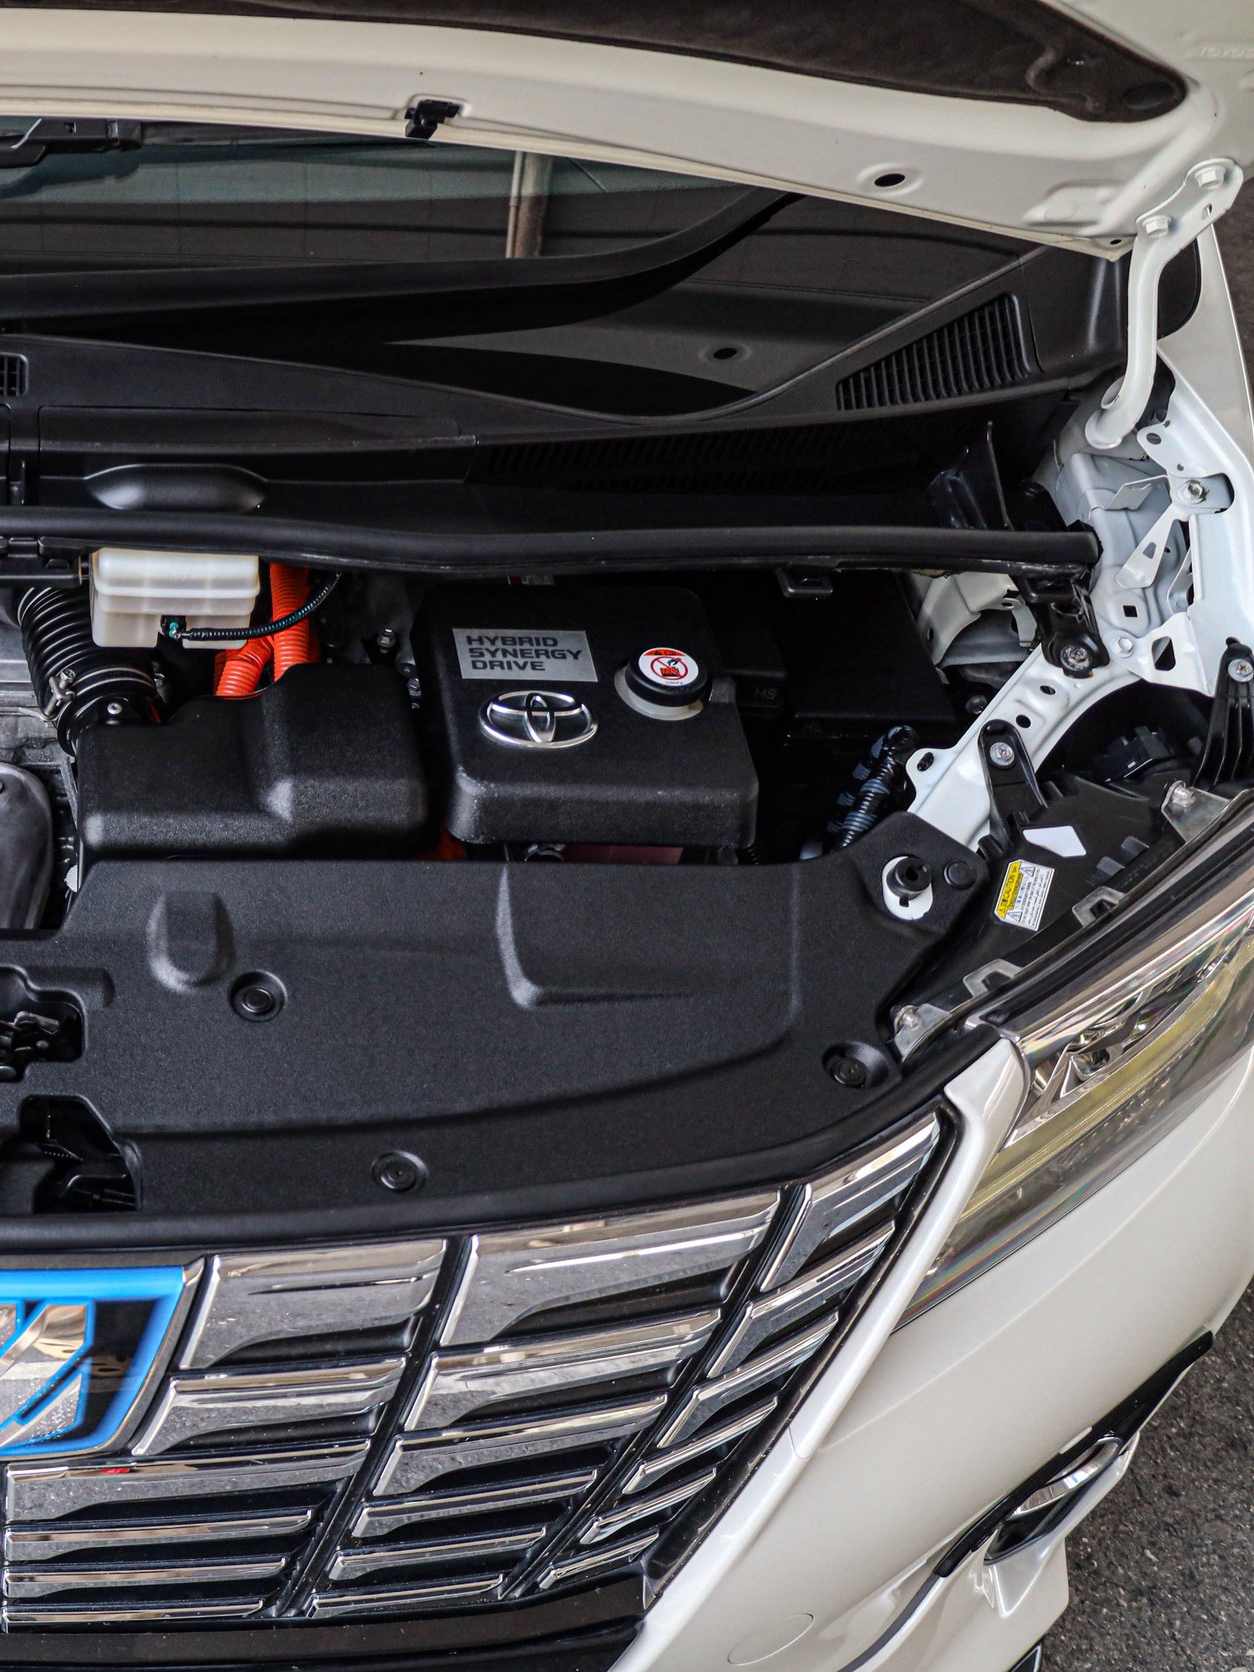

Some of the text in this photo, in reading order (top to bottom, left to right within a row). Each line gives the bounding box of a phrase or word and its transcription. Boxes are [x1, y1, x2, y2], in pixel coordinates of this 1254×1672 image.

[466, 635, 559, 647] HYBRID
[469, 648, 583, 660] SYNERGY
[471, 660, 546, 671] DRIVE
[1003, 874, 1015, 898] CAUTION
